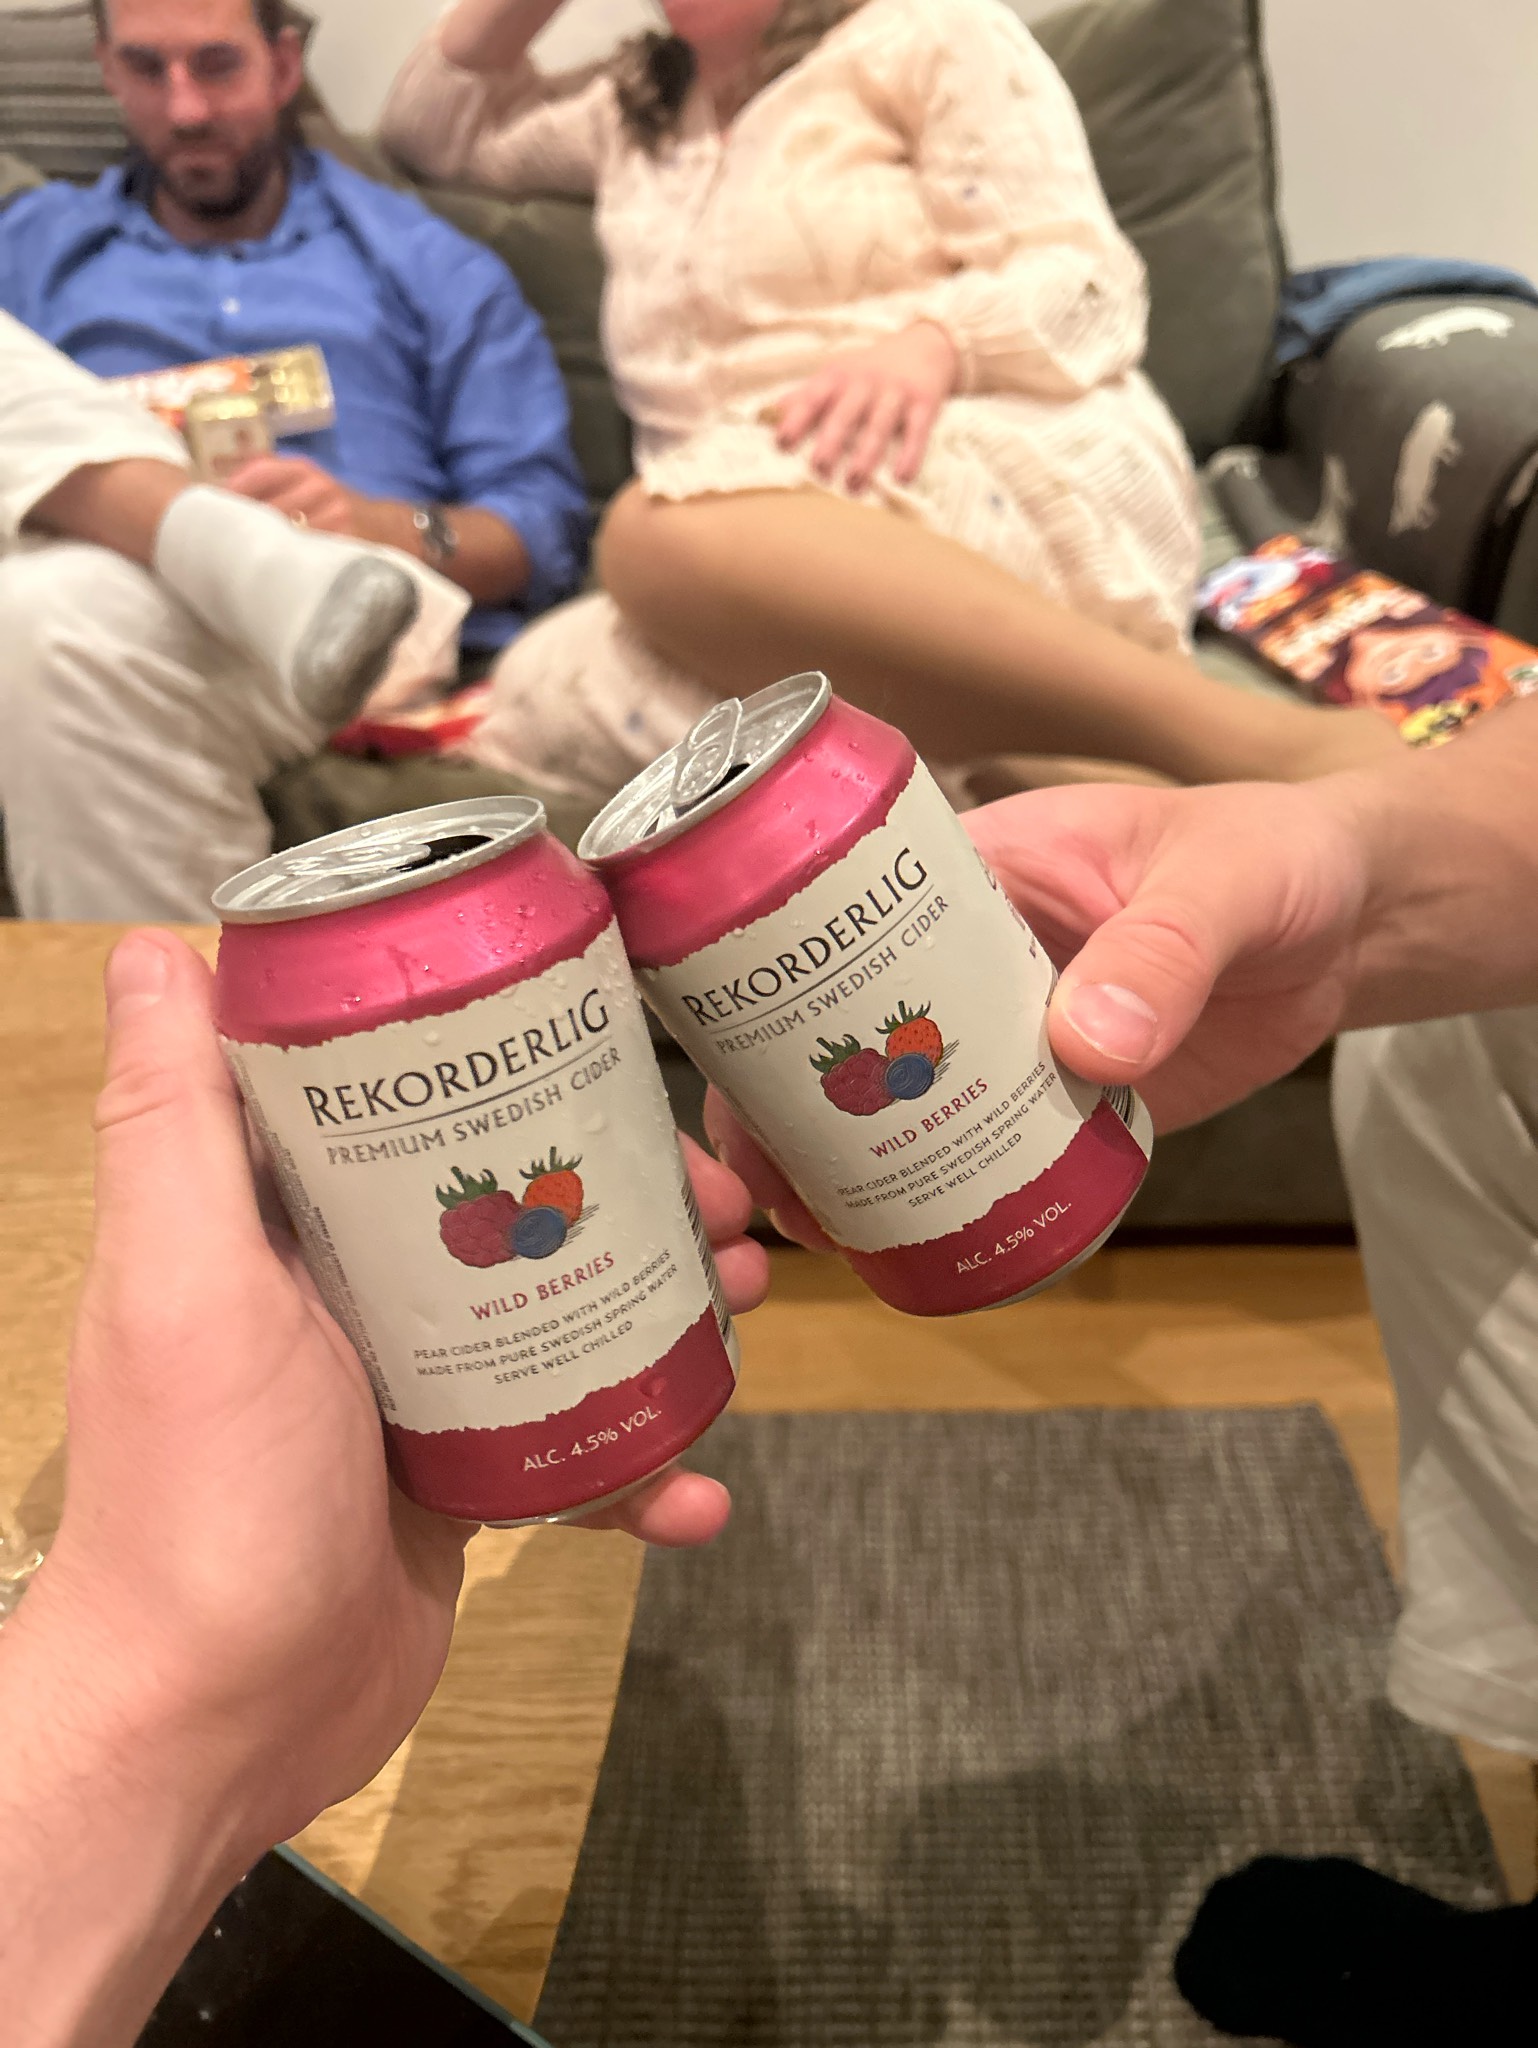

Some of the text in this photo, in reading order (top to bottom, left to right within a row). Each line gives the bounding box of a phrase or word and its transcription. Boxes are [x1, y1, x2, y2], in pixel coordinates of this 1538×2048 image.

[681, 847, 928, 1026] REKORDERLIG
[715, 1010, 806, 1054] PREMIUM
[807, 946, 898, 1017] SWEDISH
[901, 895, 949, 947] CIDER
[303, 988, 610, 1127] REKORDERLIG
[326, 1047, 622, 1166] PREMIUM SWEDISH CIDER
[838, 1061, 1046, 1197] PEAR CIDER BLENDED WITH WILD BERRIES
[844, 1072, 1057, 1210] MADE FROM PURE SWEDISH SPRING WATER
[869, 1078, 988, 1158] WILD BERRIES
[908, 1132, 1022, 1208] SERVE WELL CHILLED
[470, 1251, 615, 1320] WILD BERRIES
[956, 1201, 1072, 1274] ALC. 4.5% VOL.
[414, 1249, 671, 1359] PEAR CIDER BLENDED WITH WILD BERRIES
[416, 1264, 678, 1376] MADE FROM PURE SWEDISH SPRING WATER
[494, 1320, 633, 1384] SERVE WELL CHILLED
[523, 1406, 662, 1471] ALC. 4.5% VOL.
